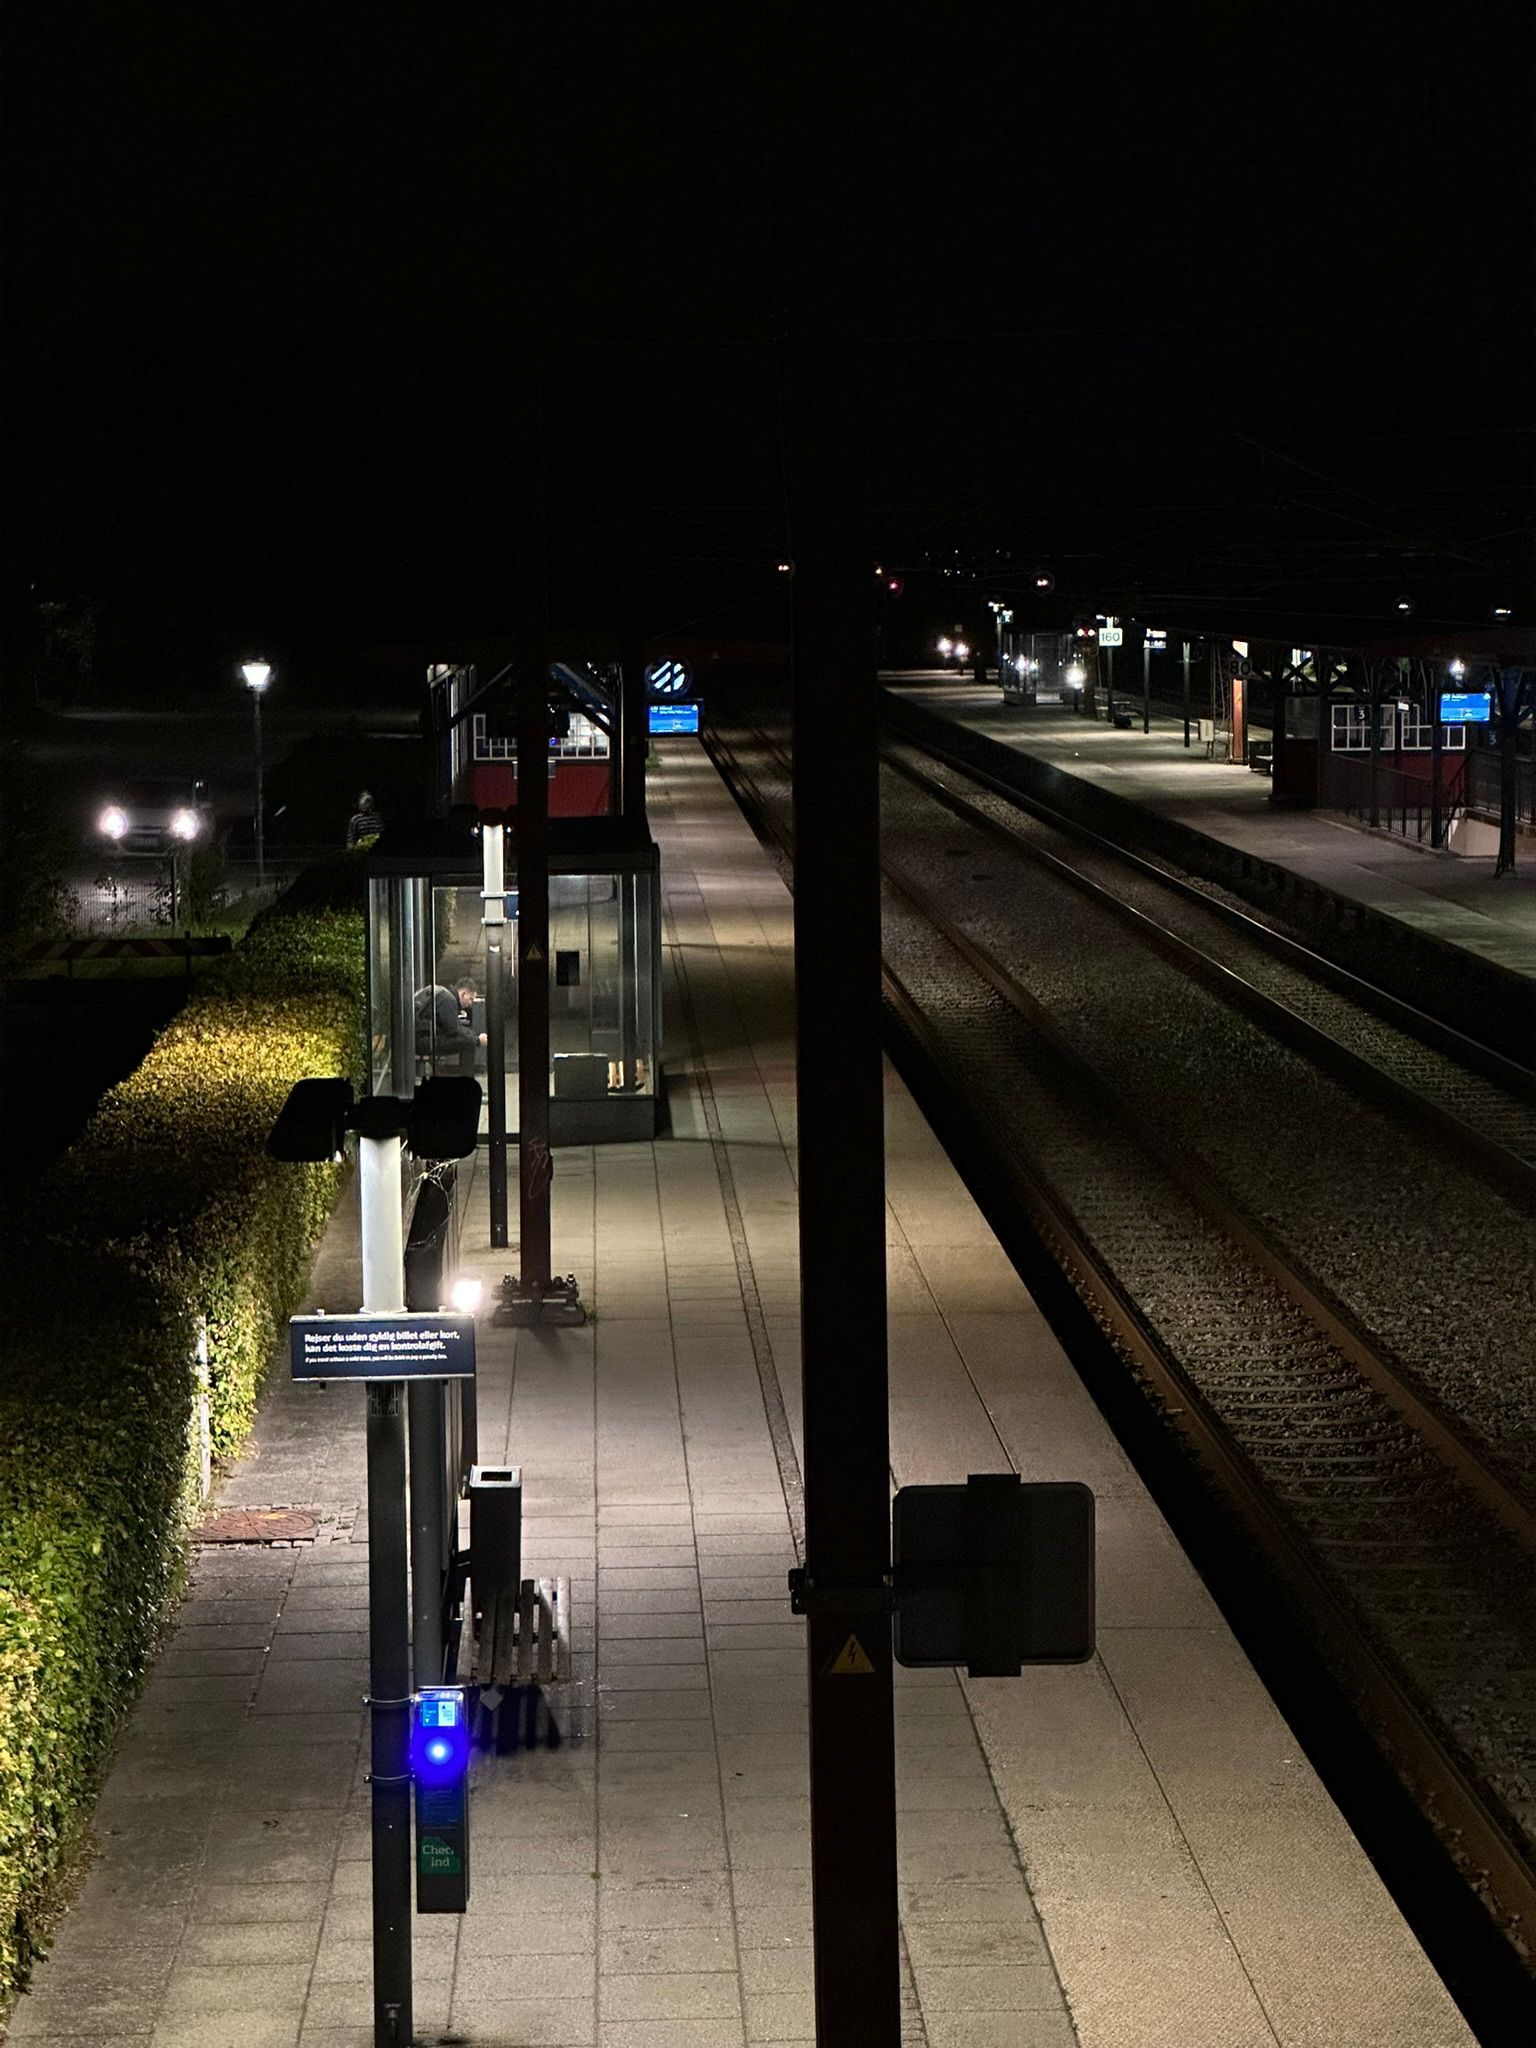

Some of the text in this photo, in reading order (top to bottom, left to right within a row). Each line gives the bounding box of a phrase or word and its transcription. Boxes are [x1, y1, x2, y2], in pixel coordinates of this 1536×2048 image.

[1102, 632, 1120, 642] 160
[1230, 660, 1250, 675] 80
[304, 1329, 460, 1344] Rejser du uden gyldig billet eller kort,
[305, 1340, 446, 1353] kan det koste dig en kontrolafgift.
[422, 1844, 455, 1856] Chec
